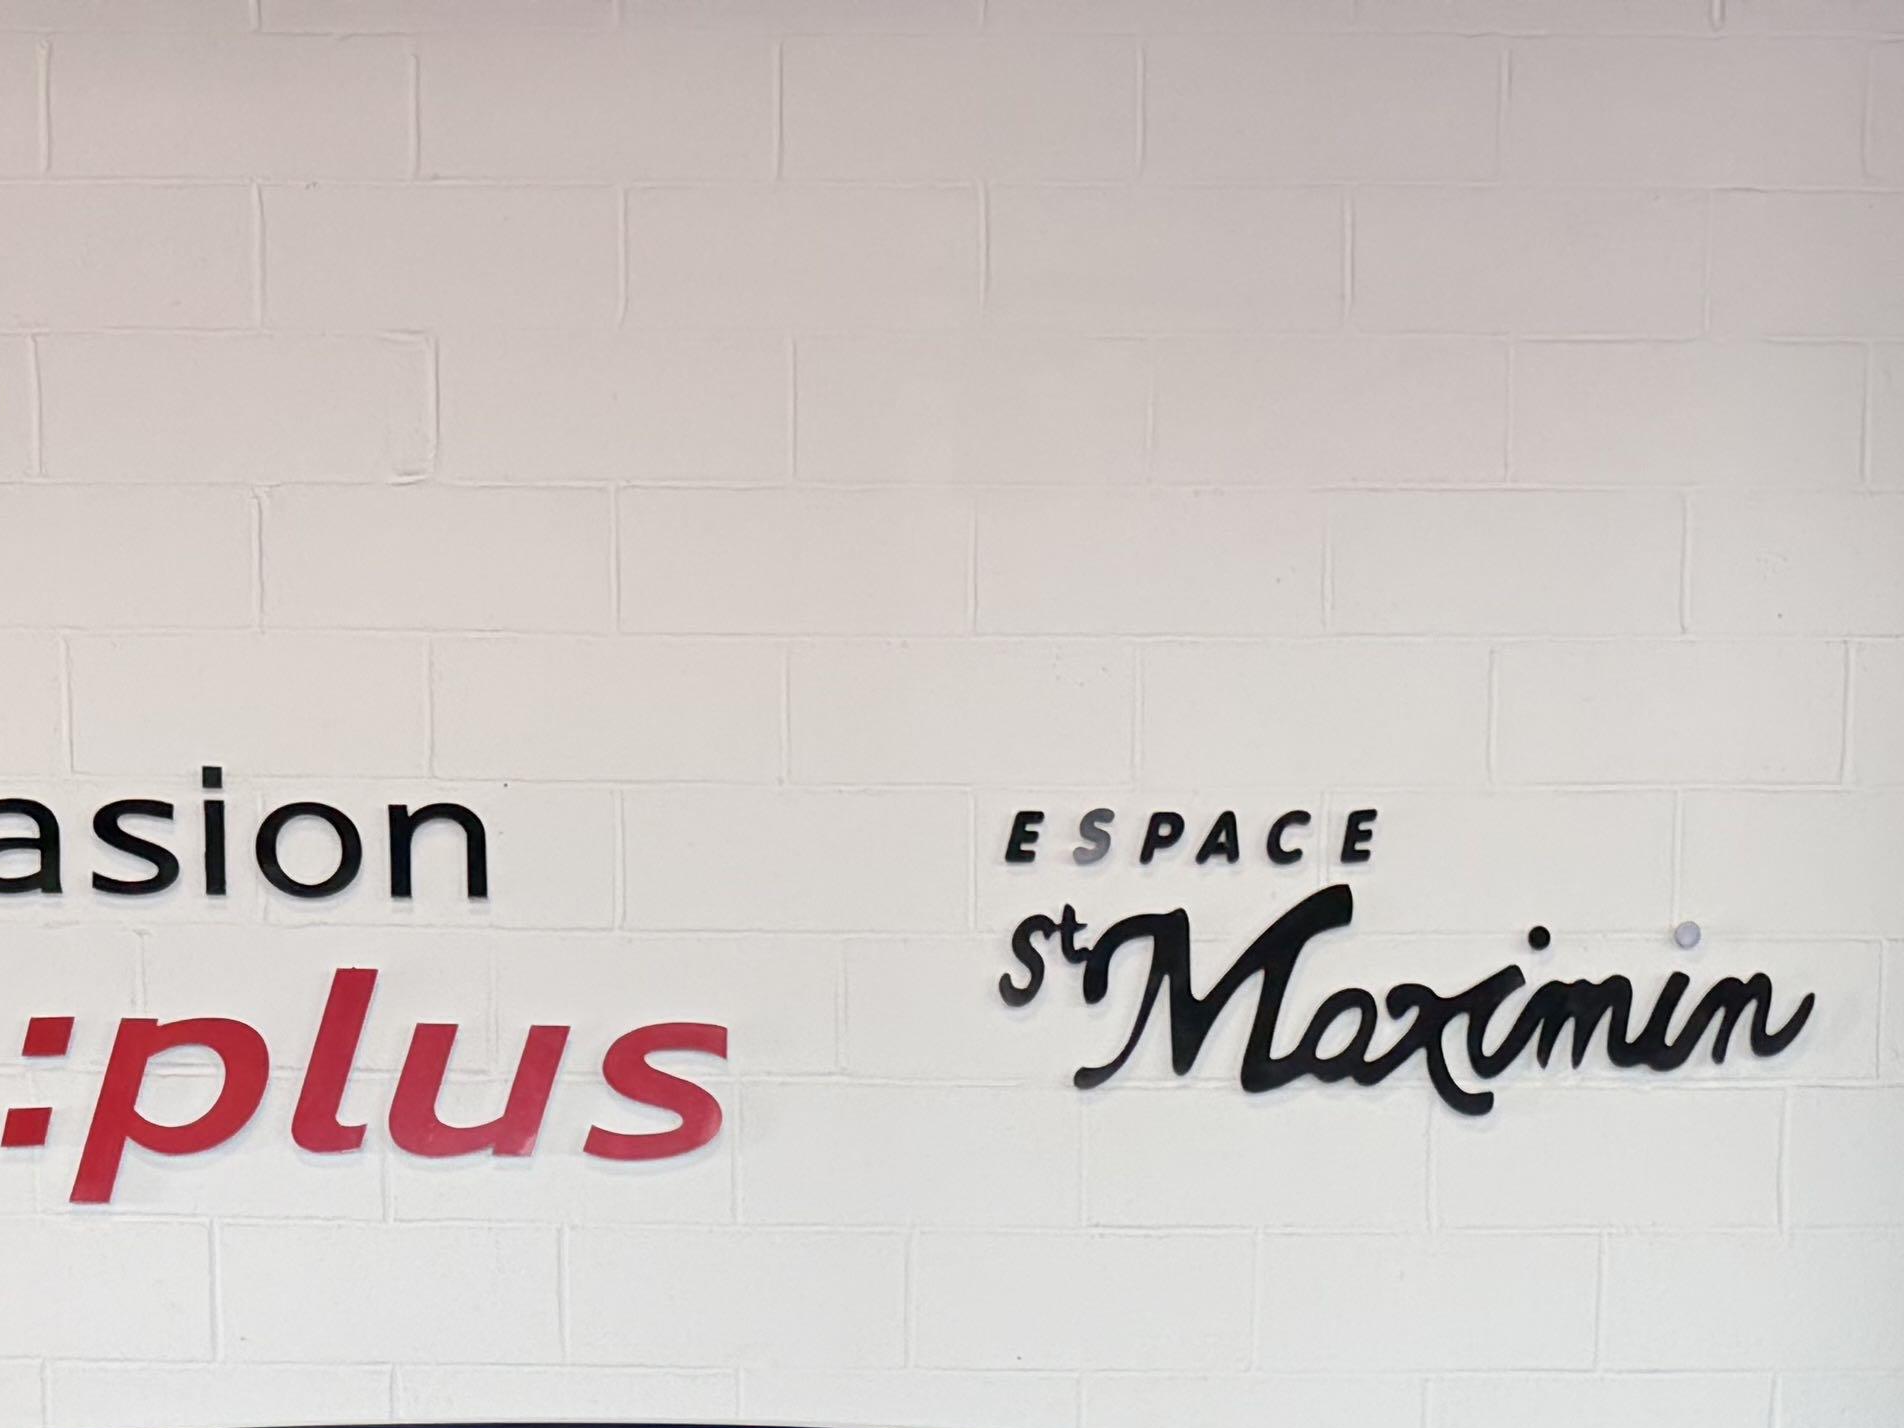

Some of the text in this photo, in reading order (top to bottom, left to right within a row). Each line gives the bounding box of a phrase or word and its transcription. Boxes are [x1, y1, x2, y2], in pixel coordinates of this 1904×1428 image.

[1004, 808, 1378, 866] ESPACE
[1, 967, 727, 1203] :plus
[998, 884, 1816, 1117] St Maximin
